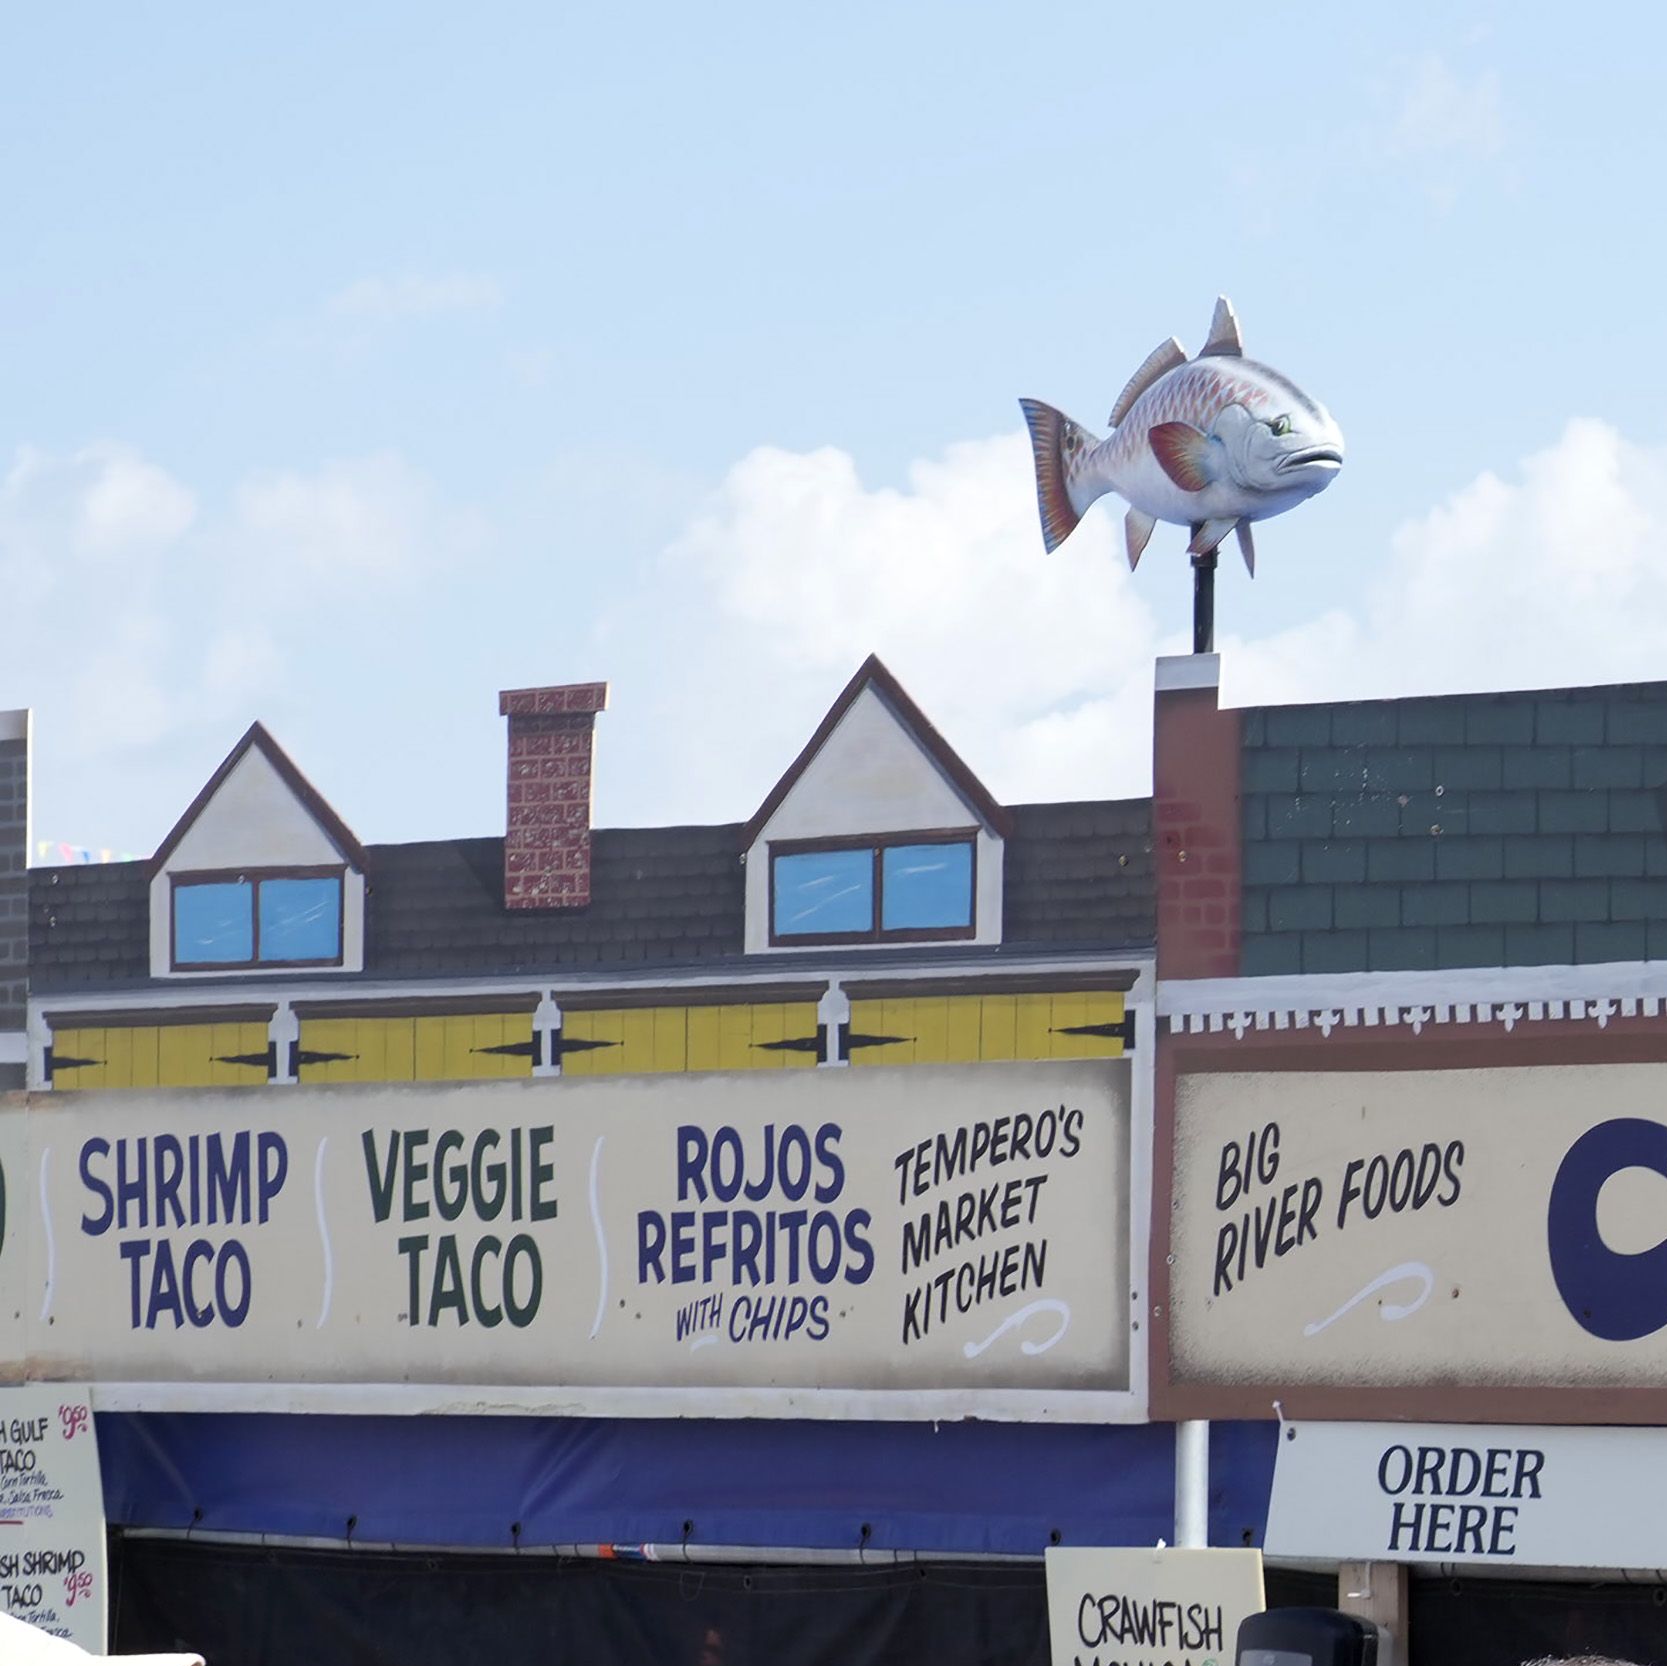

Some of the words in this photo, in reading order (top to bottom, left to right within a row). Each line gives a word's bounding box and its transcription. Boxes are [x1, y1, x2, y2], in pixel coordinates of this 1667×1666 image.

[79, 1130, 288, 1236] SHRIMP
[362, 1125, 557, 1223] VEGGIE
[677, 1123, 845, 1204] ROJOS
[895, 1104, 1084, 1206] TEMPERO'S
[1216, 1122, 1280, 1211] BIG
[638, 1208, 874, 1287] REFRITOS
[902, 1174, 1048, 1275] MARKET
[1214, 1177, 1322, 1297] RIVER
[1337, 1140, 1464, 1230] FOODS
[120, 1239, 251, 1330] TACO
[398, 1234, 542, 1328] TACO
[676, 1292, 723, 1342] WITH
[729, 1295, 829, 1343] CHIPS
[903, 1239, 1047, 1345] KITCHEN
[10, 1418, 49, 1444] GULF
[1378, 1445, 1545, 1499] ORDER
[23, 1549, 85, 1575] SHRIMP
[1388, 1502, 1518, 1555] HERE
[2, 1583, 42, 1609] TACO
[1078, 1593, 1223, 1652] CRAWFISH
